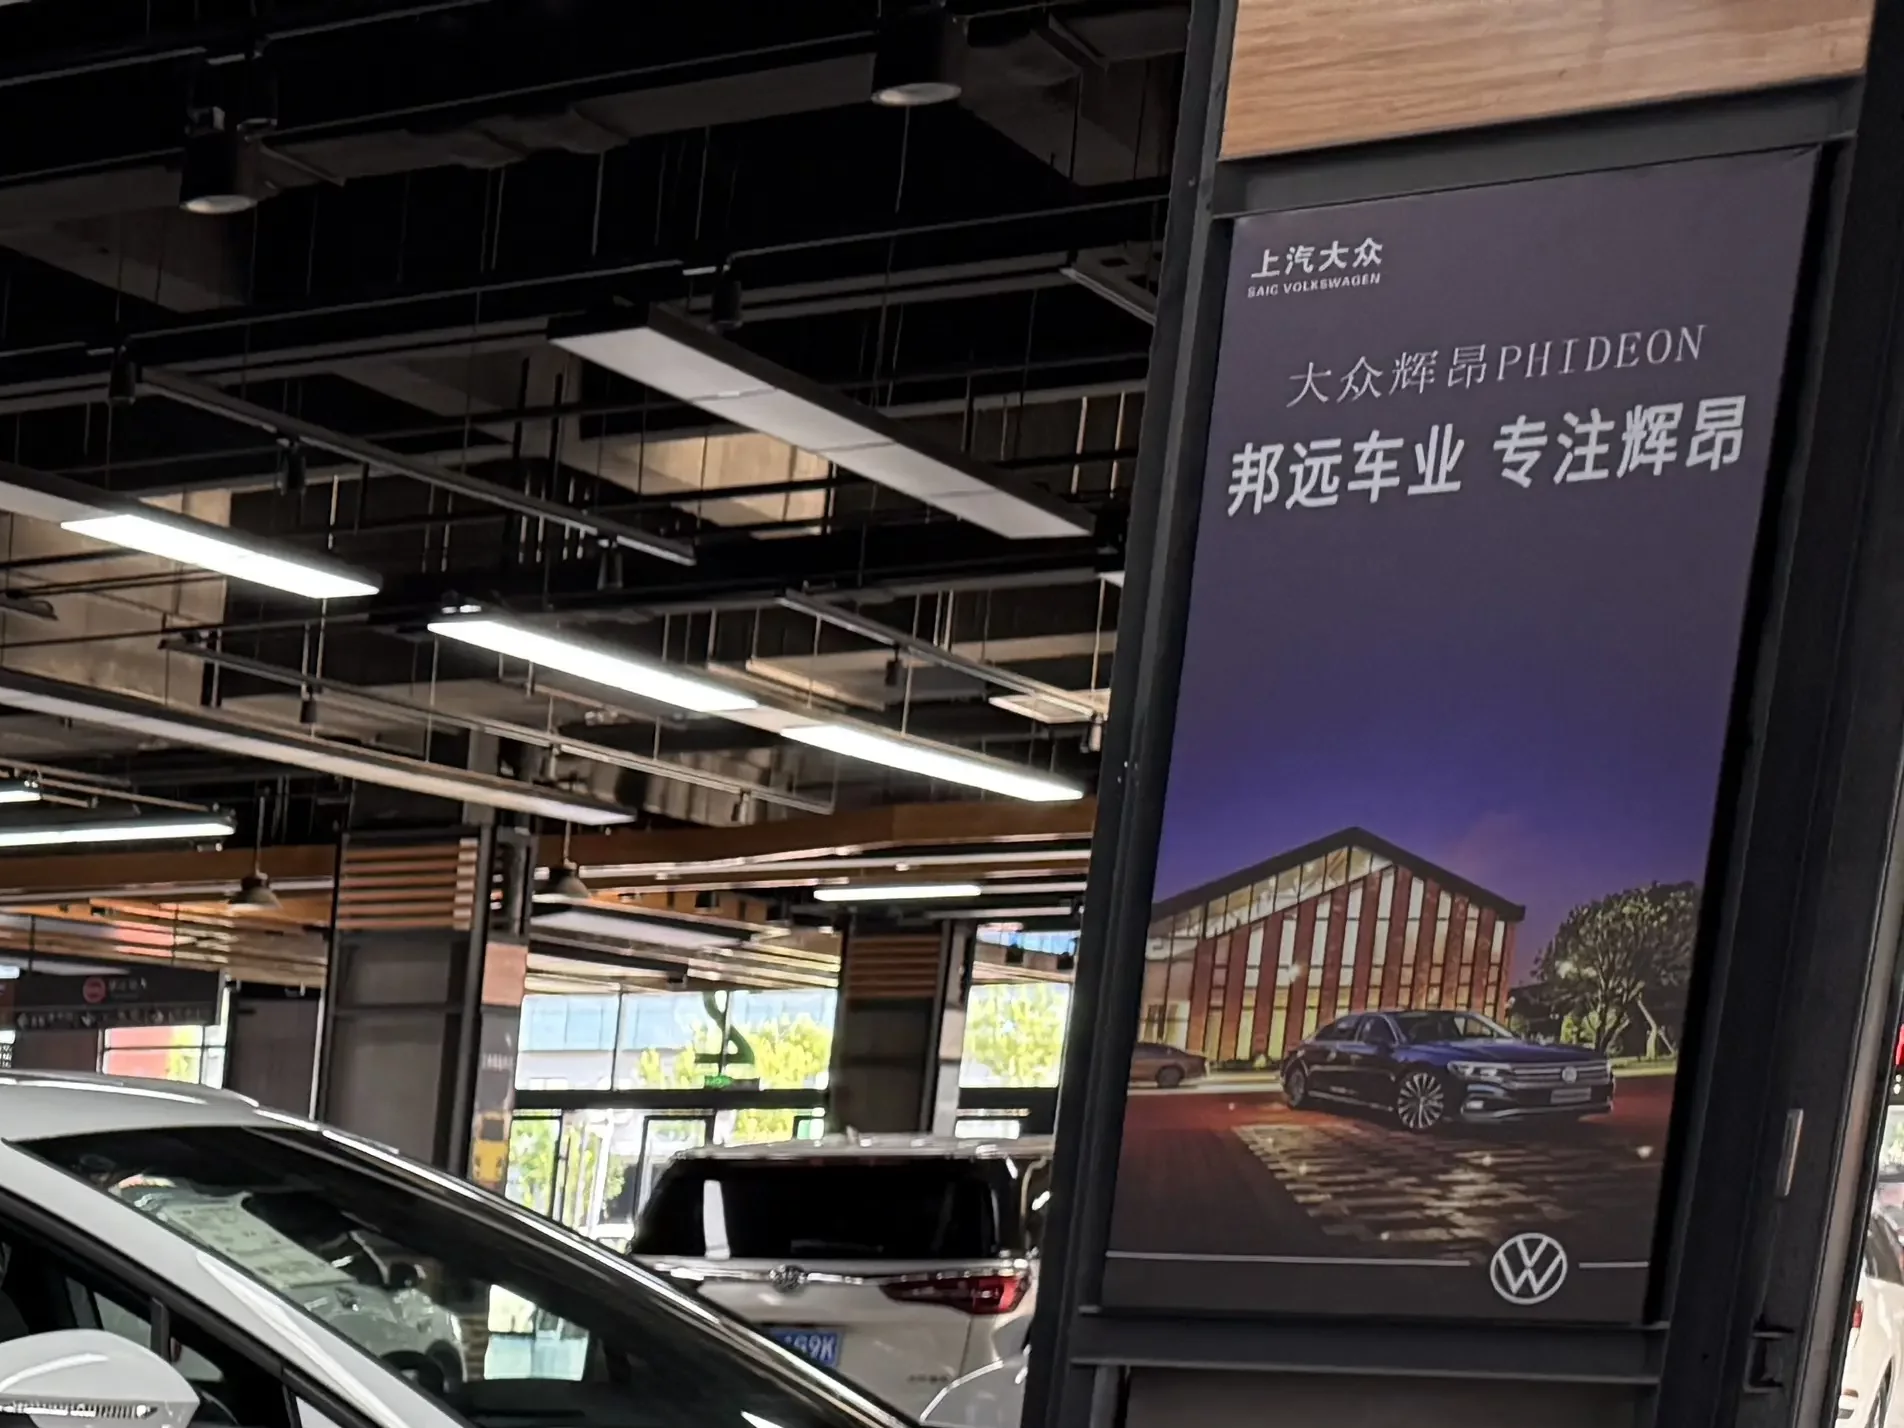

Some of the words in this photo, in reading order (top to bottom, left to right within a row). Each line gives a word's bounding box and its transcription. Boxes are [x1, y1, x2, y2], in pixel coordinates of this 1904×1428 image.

[1250, 237, 1384, 278] 上汽大众
[1247, 283, 1280, 298] SAIC
[1283, 272, 1382, 295] VOLKSWAGEN
[1226, 423, 1465, 517] 邦远车业
[1492, 394, 1747, 489] 专注辉昂
